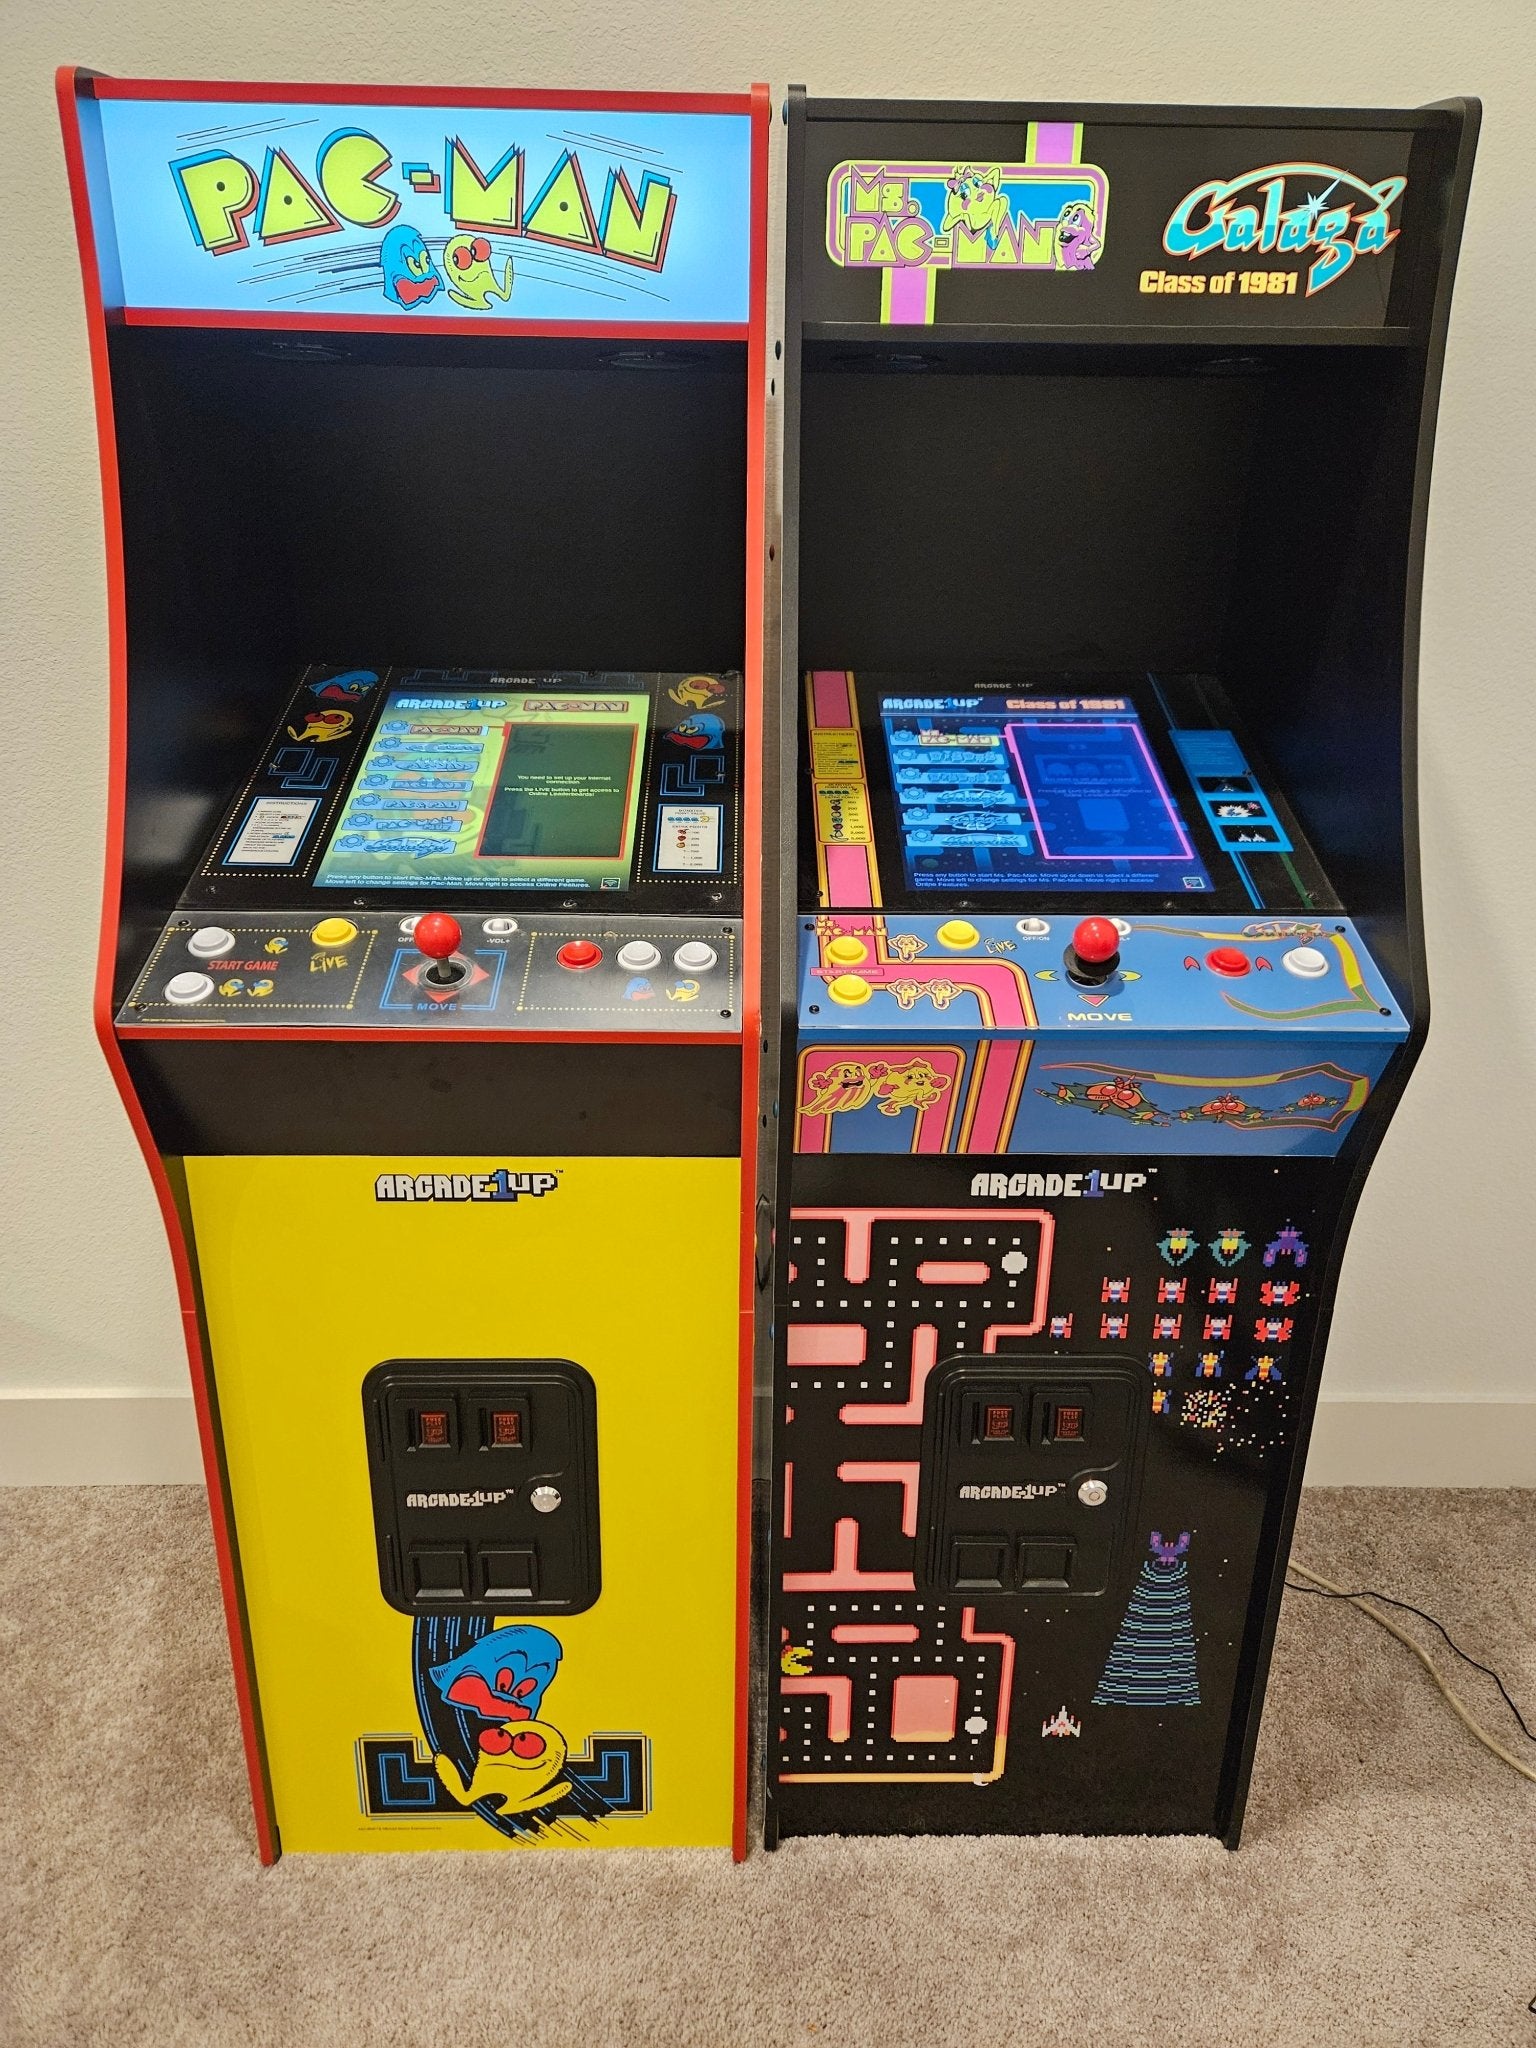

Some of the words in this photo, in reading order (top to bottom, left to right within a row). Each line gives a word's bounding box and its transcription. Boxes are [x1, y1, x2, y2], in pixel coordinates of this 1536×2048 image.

[169, 127, 677, 272] PAC-MAN
[1163, 162, 1407, 297] Galaga
[844, 213, 1056, 268] PAC-MAN
[1139, 270, 1205, 293] Class
[1209, 271, 1236, 294] of
[1239, 271, 1298, 294] 1981
[526, 701, 628, 711] PAC-MAN
[1006, 699, 1057, 710] Class
[1058, 699, 1078, 710] of
[816, 926, 888, 936] PAC-MAN
[207, 960, 243, 971] START
[244, 960, 279, 971] GAME
[416, 1003, 457, 1011] MOVE
[1067, 1012, 1133, 1021] MOVE
[375, 1169, 558, 1202] ARCADE1UP
[970, 1169, 1147, 1199] ARCADE1UP
[406, 1490, 507, 1508] ARCADE1UP
[960, 1483, 1058, 1500] ARCADE1UP
